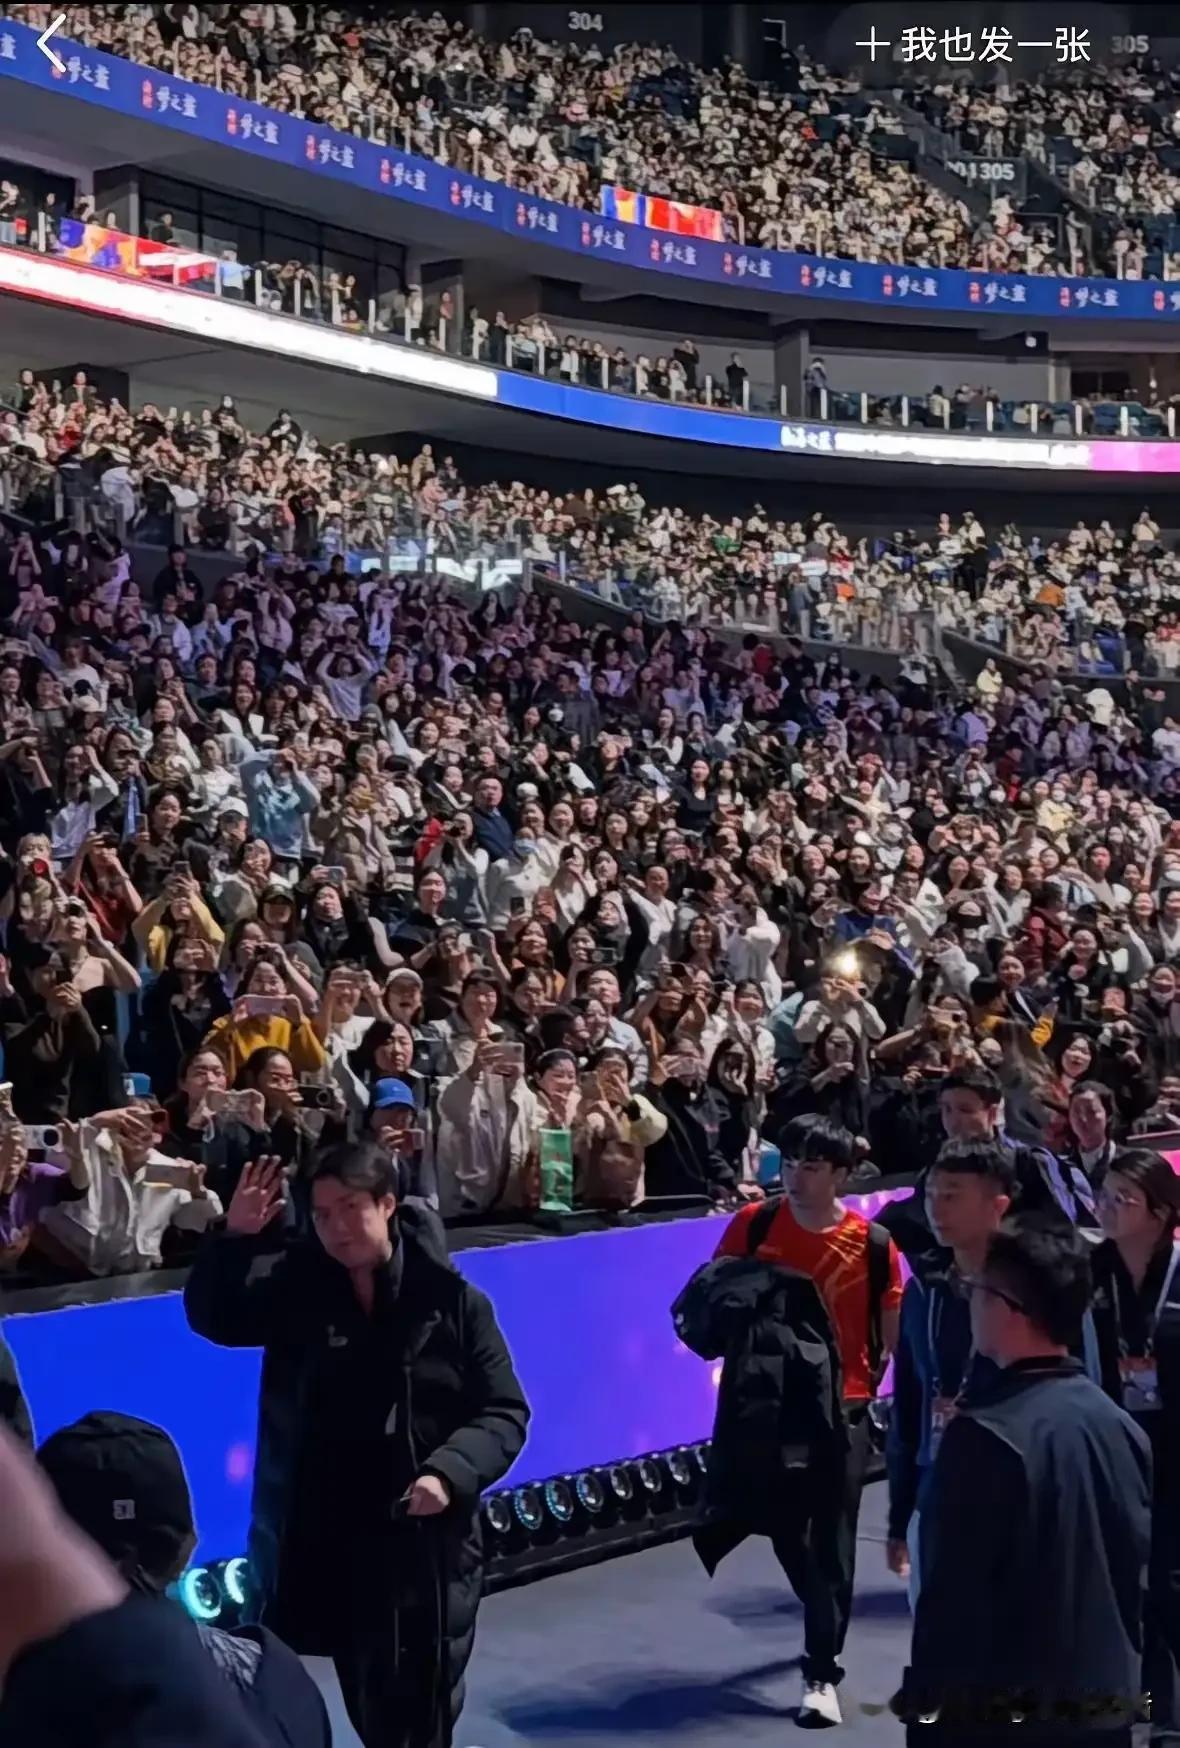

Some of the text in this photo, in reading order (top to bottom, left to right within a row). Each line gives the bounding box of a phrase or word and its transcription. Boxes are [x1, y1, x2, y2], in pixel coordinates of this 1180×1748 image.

[568, 11, 603, 32] 304
[1112, 35, 1149, 54] 305
[979, 162, 1015, 181] 305
